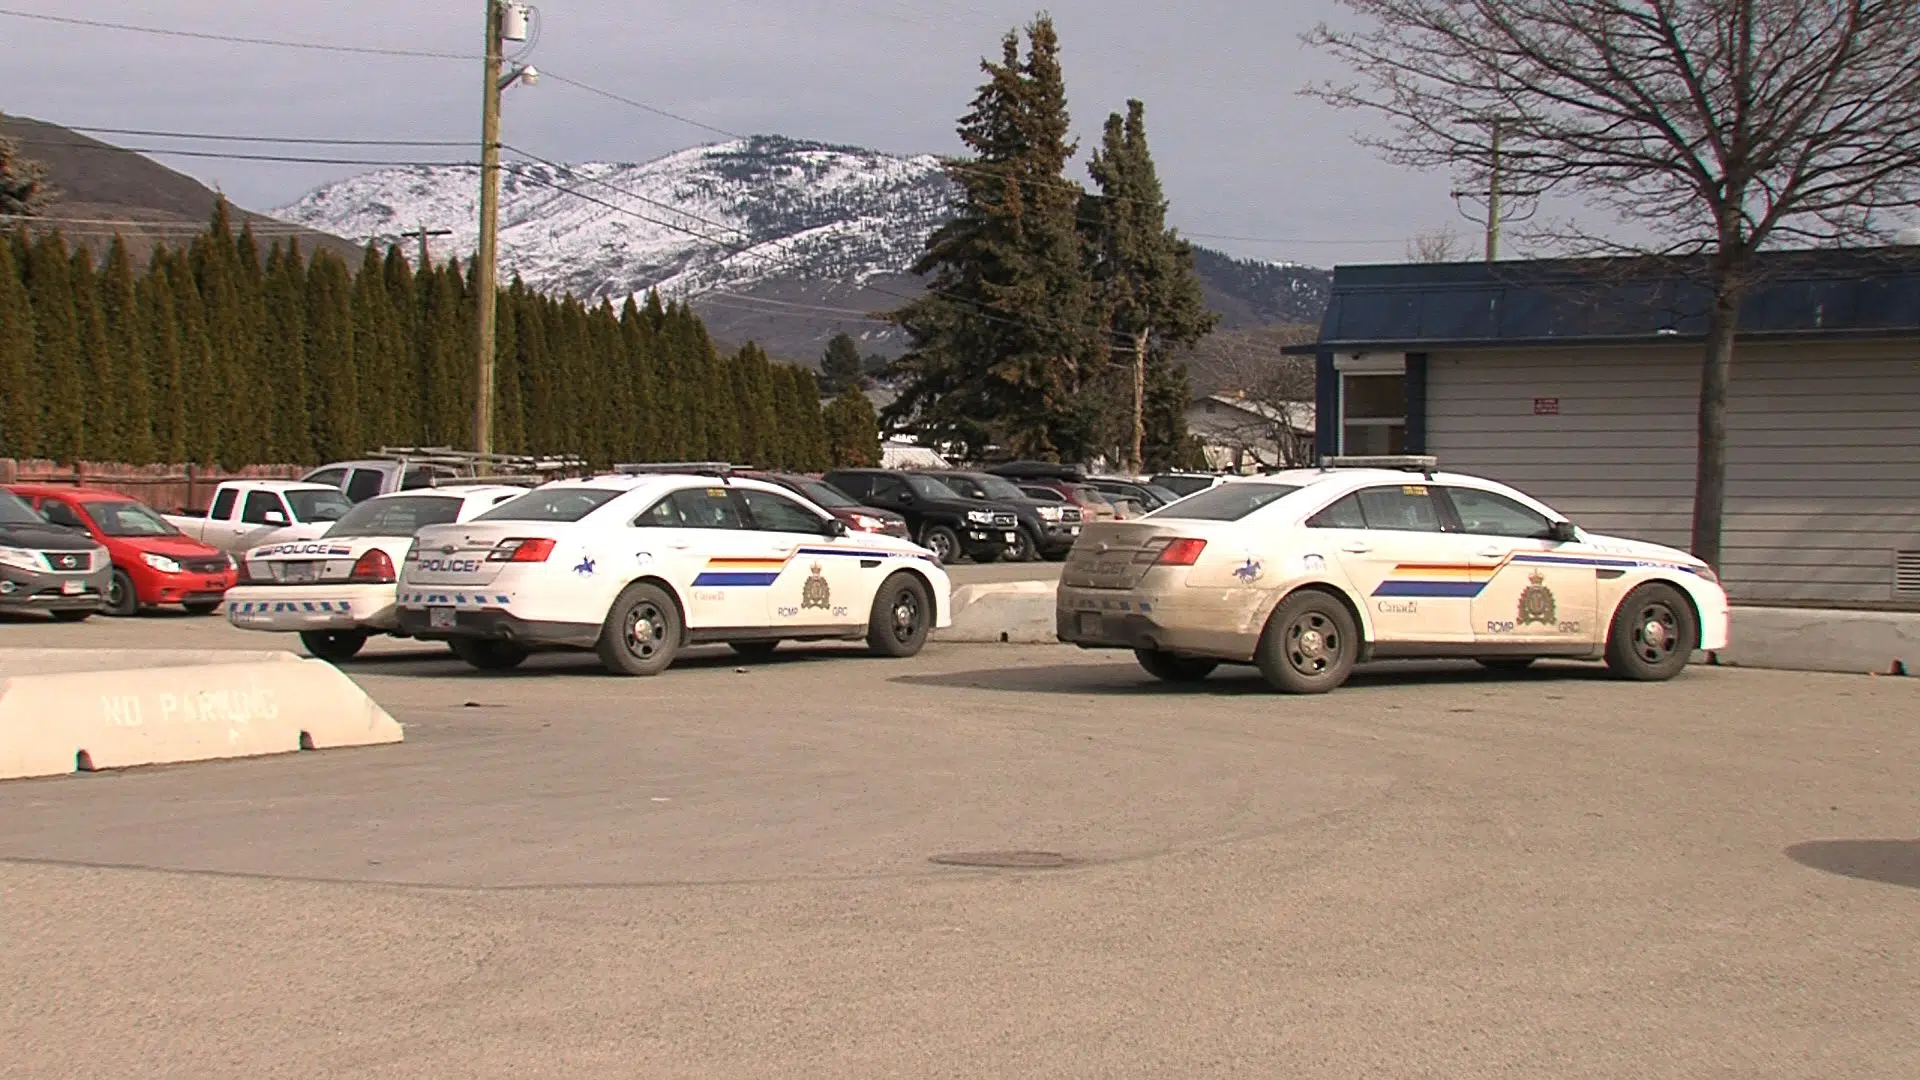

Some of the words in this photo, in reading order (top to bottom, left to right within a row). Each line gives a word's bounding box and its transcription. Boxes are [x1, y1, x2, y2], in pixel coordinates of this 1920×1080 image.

[274, 544, 328, 554] POLICE
[422, 559, 475, 571] POLICE
[778, 607, 798, 617] RCMP
[832, 606, 849, 617] GRC
[1377, 600, 1417, 613] Canada
[1487, 620, 1514, 632] RCMP
[1559, 621, 1580, 633] GRC
[101, 695, 142, 727] NO
[159, 688, 279, 724] PARKING
